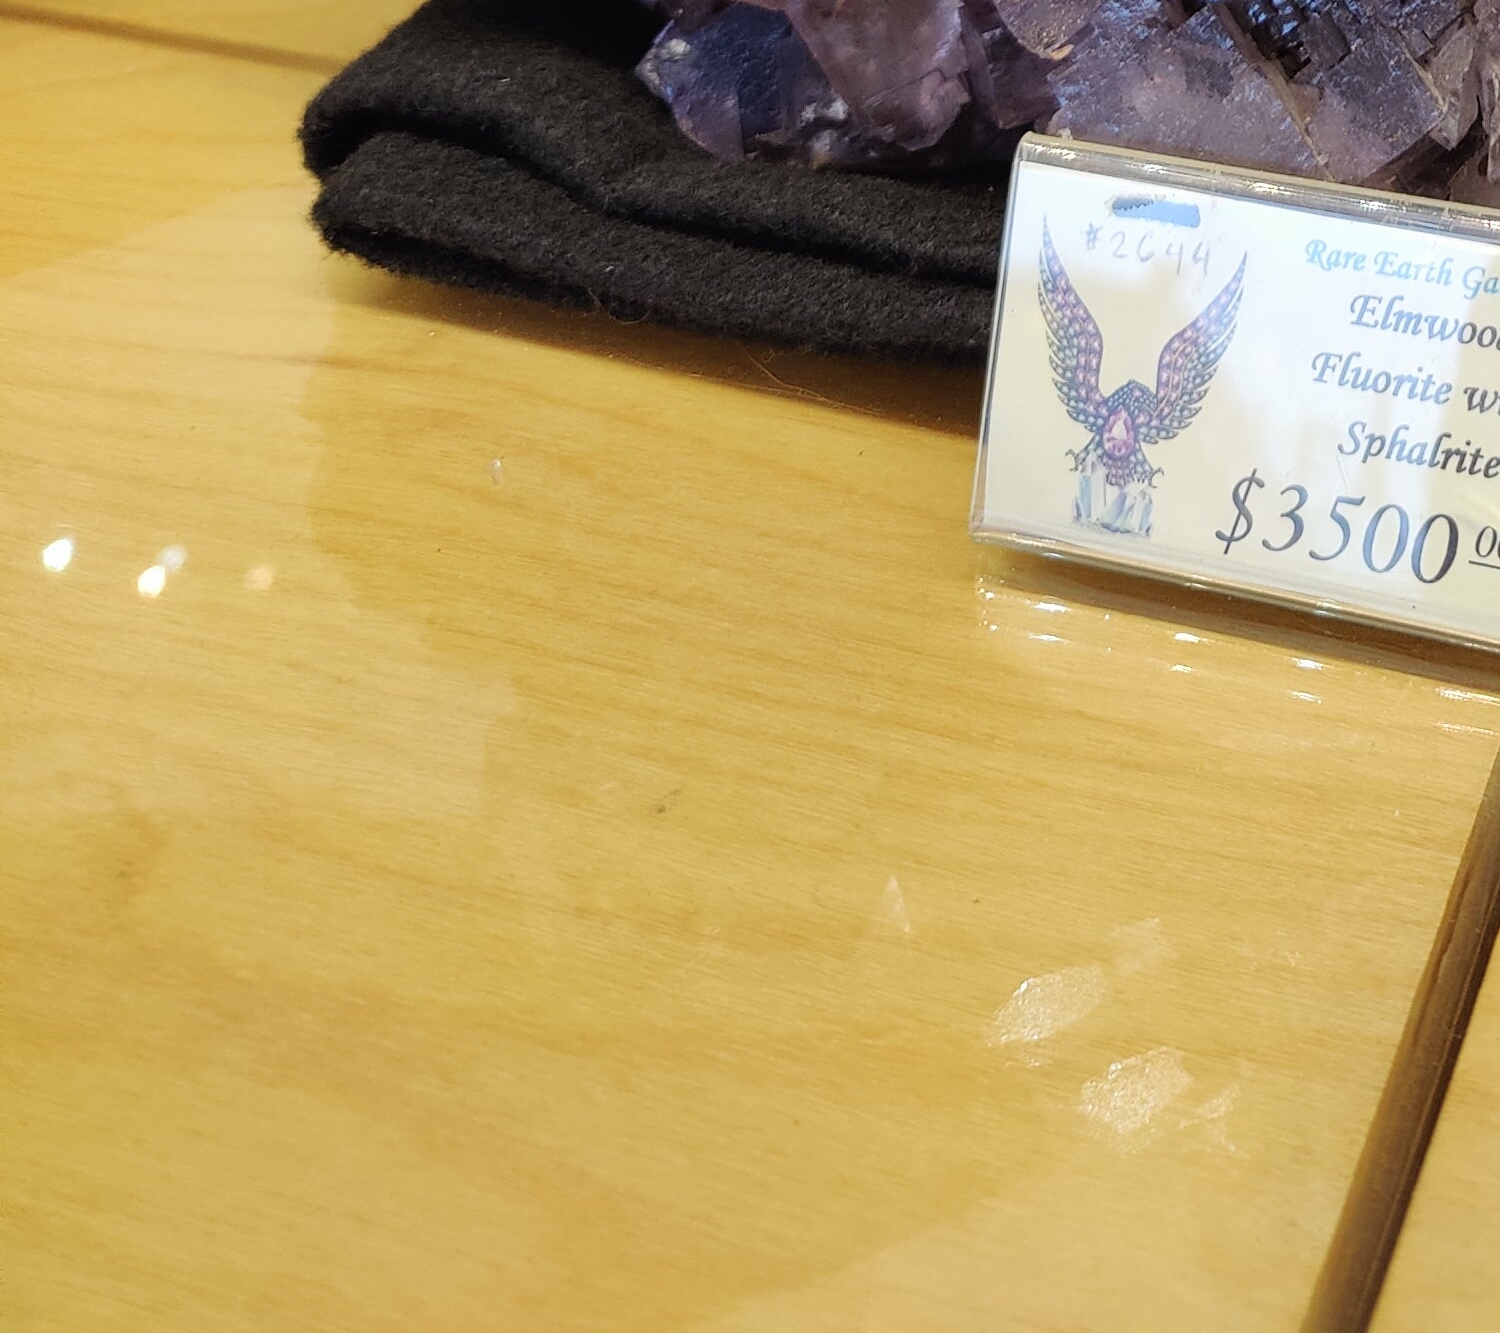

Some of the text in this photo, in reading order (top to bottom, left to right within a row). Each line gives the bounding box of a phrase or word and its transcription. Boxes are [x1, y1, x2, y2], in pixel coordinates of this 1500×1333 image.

[1305, 239, 1366, 272] Rare
[1373, 250, 1453, 286] Earth
[1311, 351, 1453, 405] Fluorite
